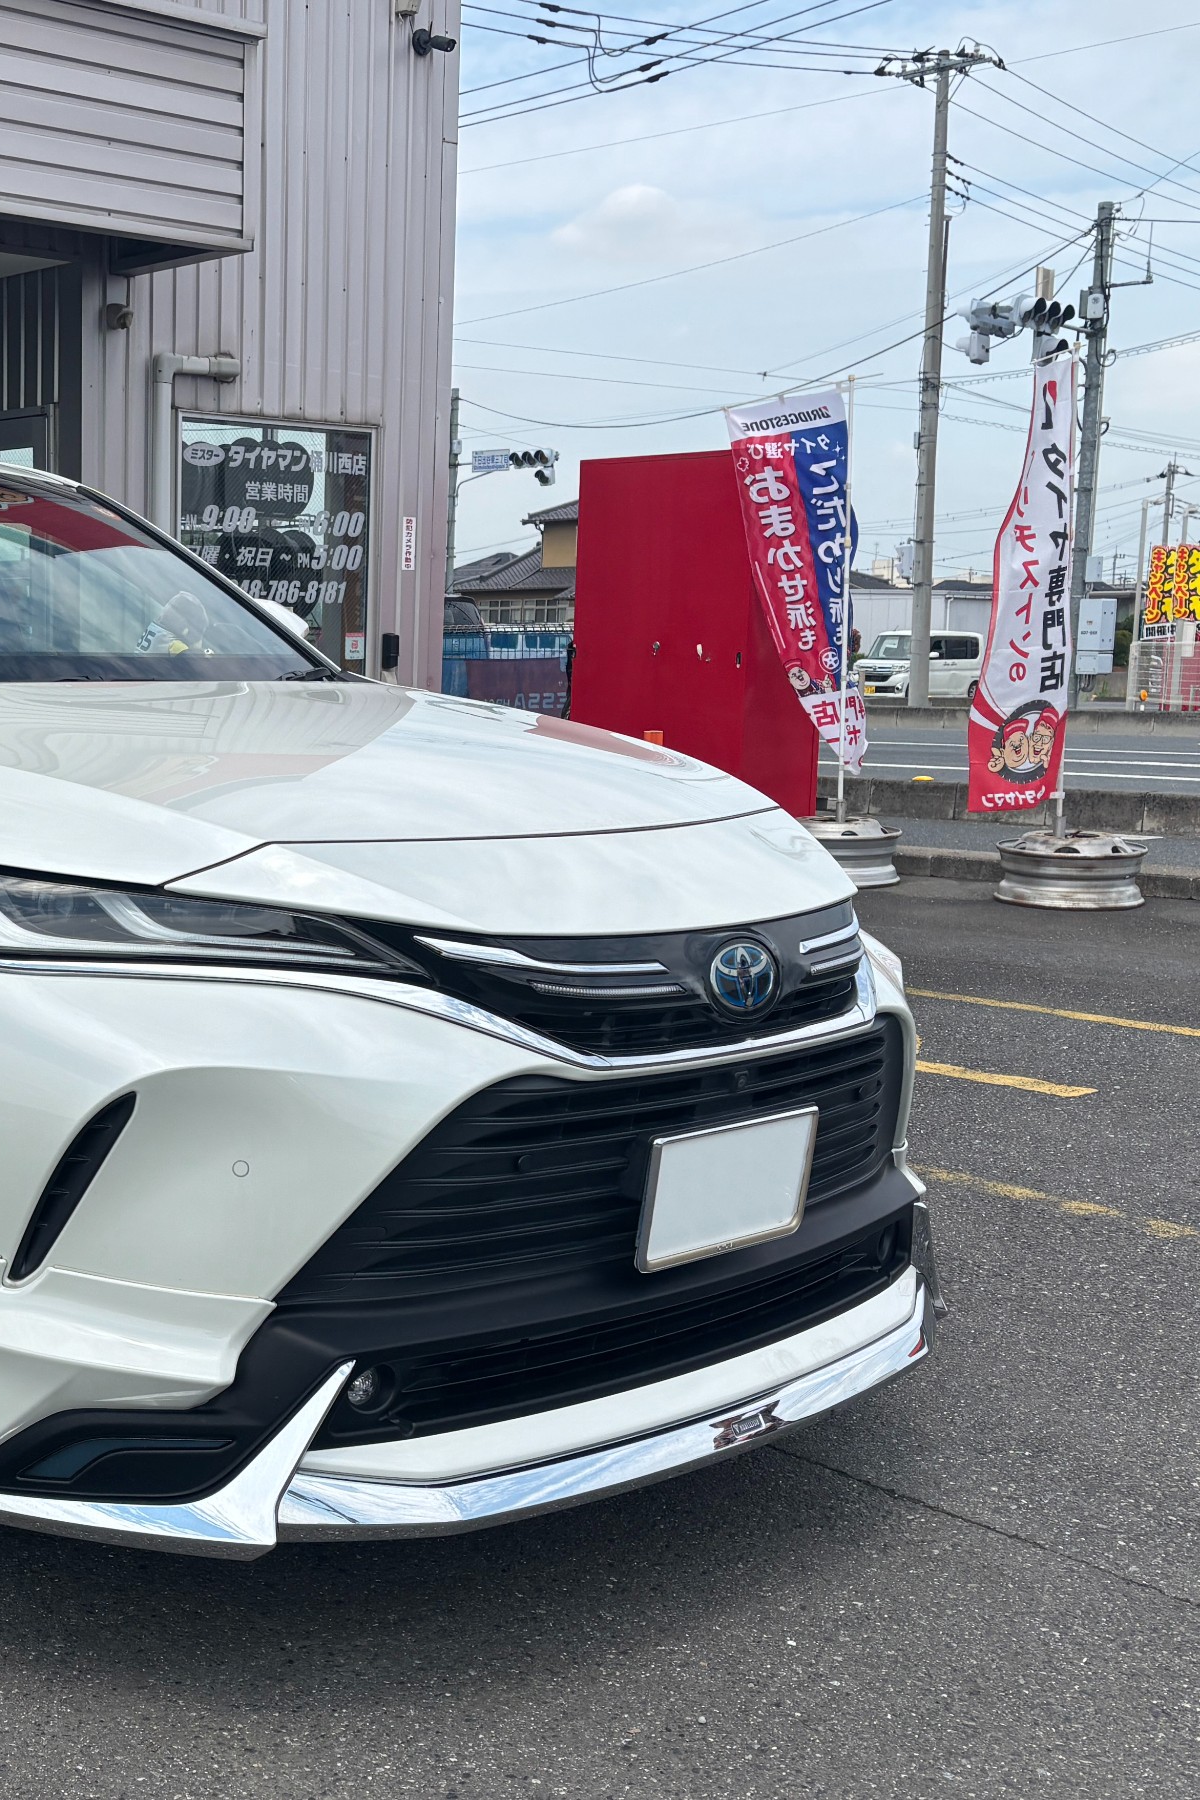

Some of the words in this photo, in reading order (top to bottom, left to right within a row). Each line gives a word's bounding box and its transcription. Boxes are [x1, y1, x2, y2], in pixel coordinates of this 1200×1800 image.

[190, 448, 220, 461] ミスター
[228, 445, 307, 472] タイヤマン
[245, 480, 309, 504] 営業時間
[201, 505, 256, 533] 9:00
[313, 510, 365, 537] 6:00
[297, 553, 311, 569] PM
[311, 544, 363, 570] 5:00
[231, 579, 347, 604] 48-786-8181
[1145, 547, 1167, 625] キャンペーン
[1174, 546, 1189, 619] キャンペーン
